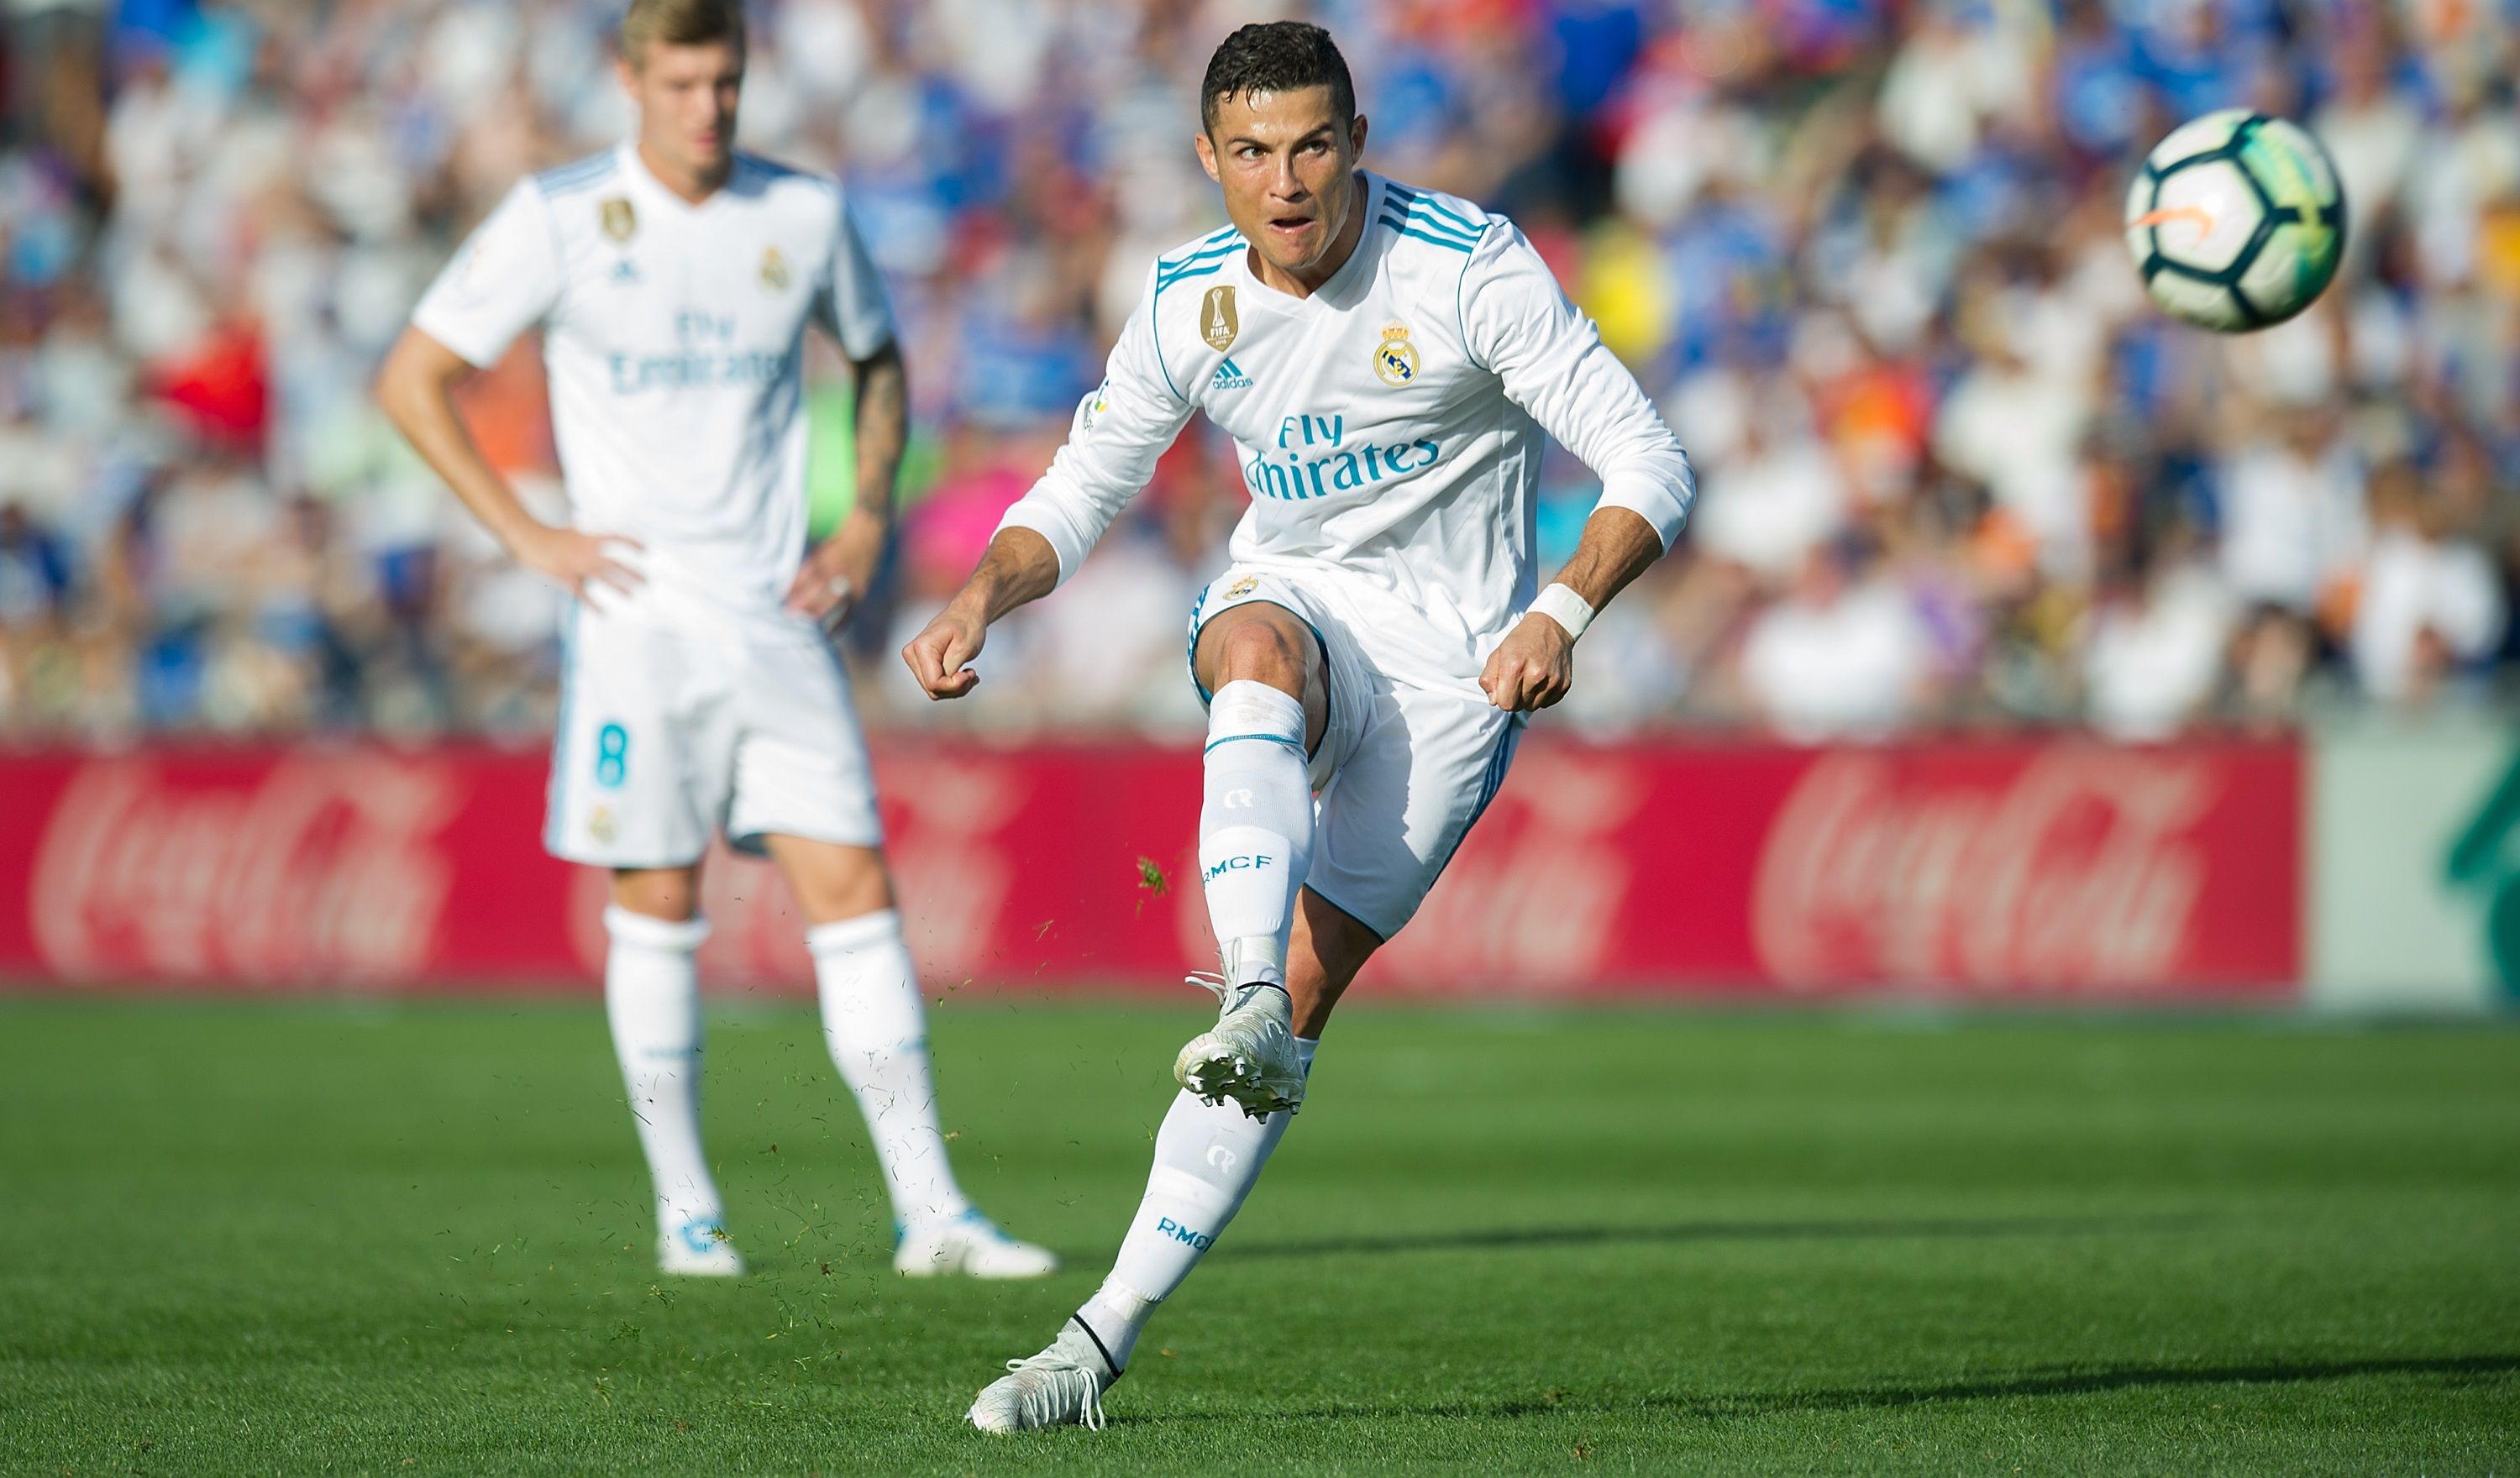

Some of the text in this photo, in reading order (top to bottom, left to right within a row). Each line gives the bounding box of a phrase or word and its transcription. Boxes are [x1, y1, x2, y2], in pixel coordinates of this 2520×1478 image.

[1210, 326, 1230, 338] FIFA
[1212, 377, 1253, 390] adidas
[1278, 415, 1343, 448] Fly
[597, 723, 627, 788] 8
